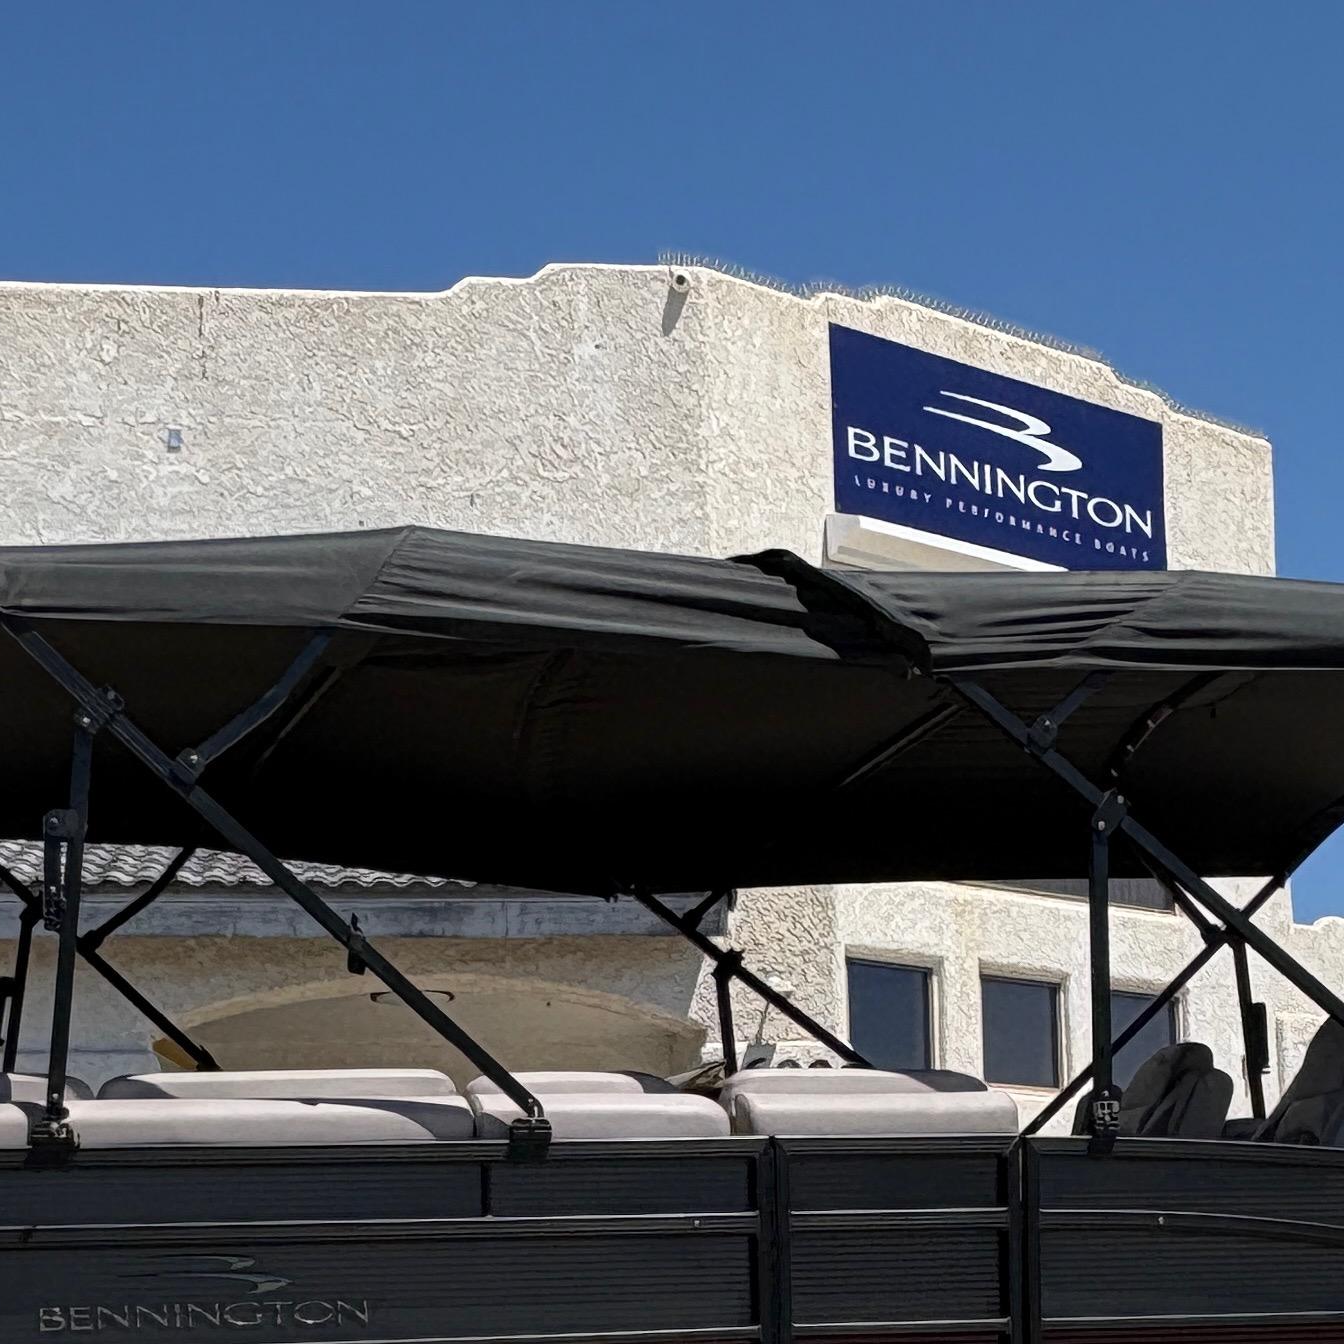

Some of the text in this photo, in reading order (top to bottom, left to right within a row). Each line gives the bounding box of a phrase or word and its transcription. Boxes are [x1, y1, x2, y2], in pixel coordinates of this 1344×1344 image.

[847, 426, 1153, 538] BENNINGTON
[854, 474, 932, 503] LUXURY
[1093, 538, 1150, 563] BOATS
[39, 1300, 369, 1332] BENNINGTON
